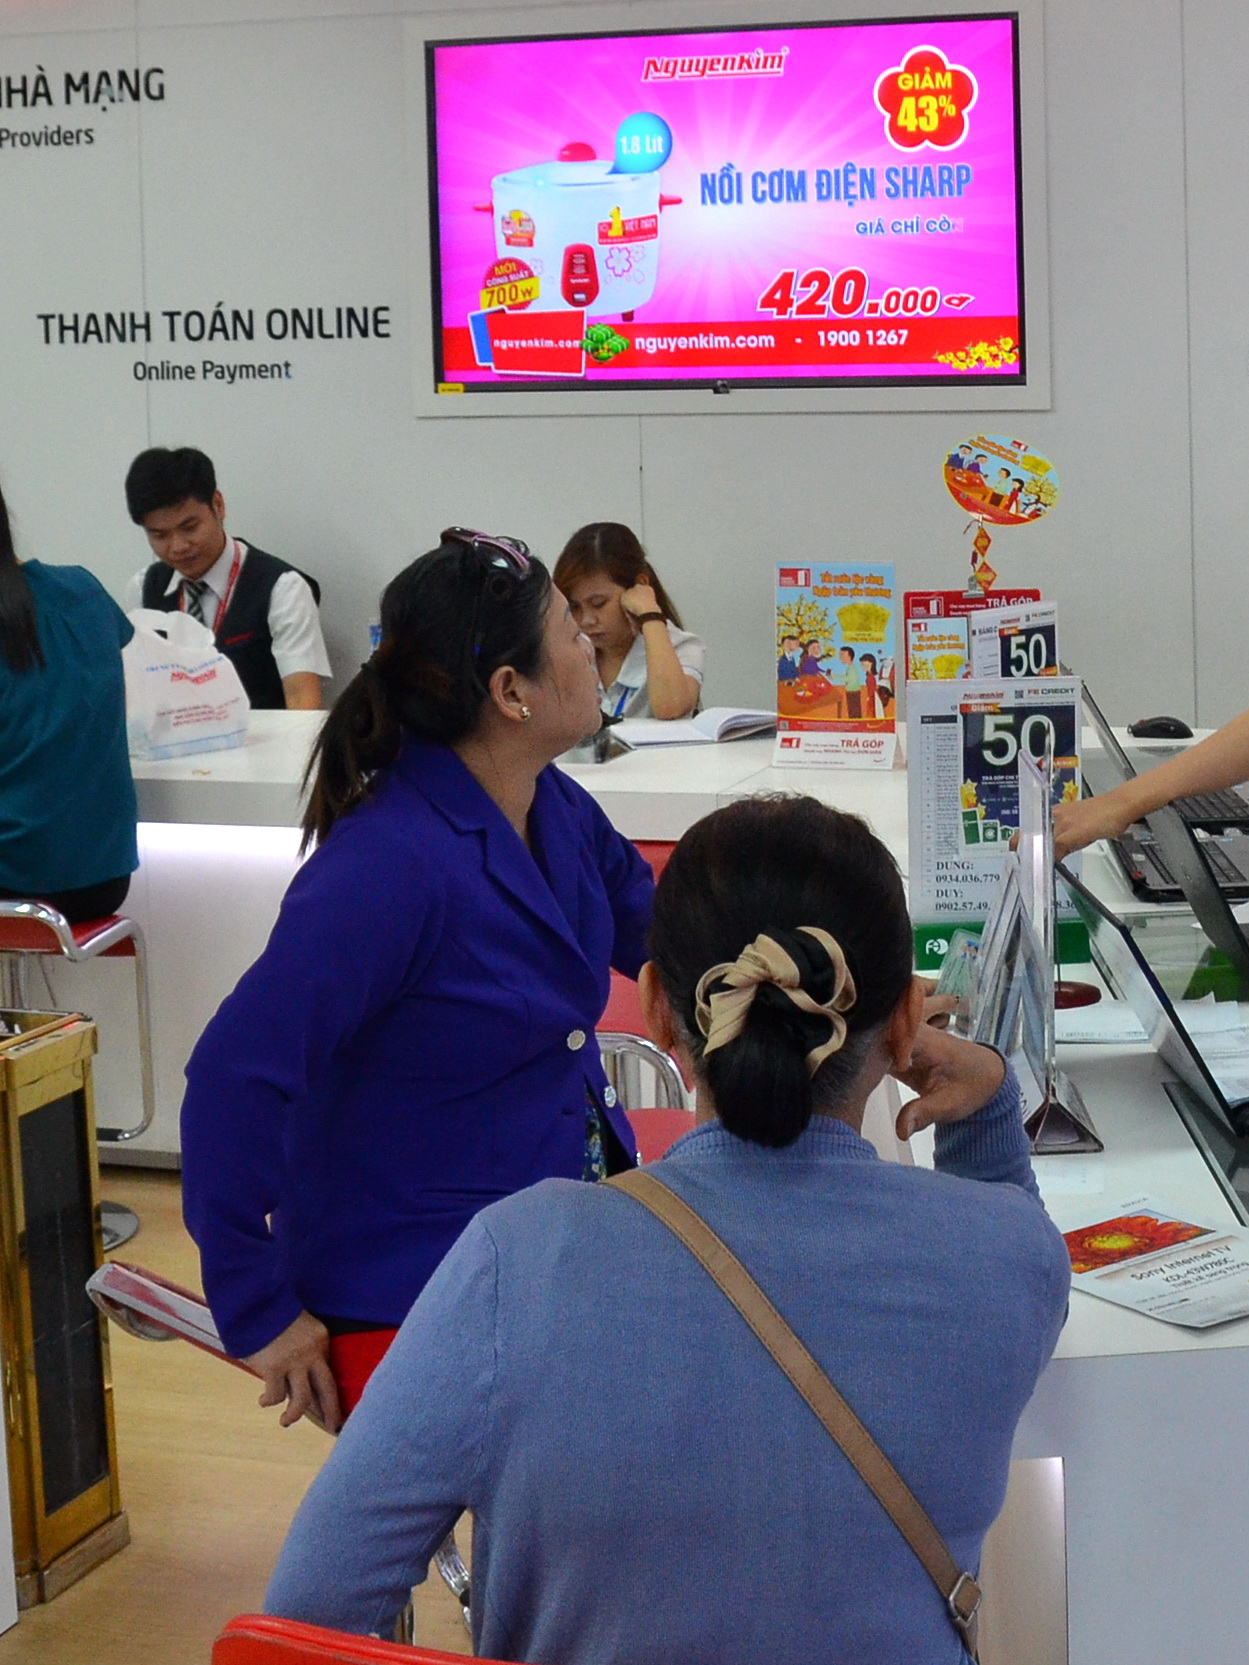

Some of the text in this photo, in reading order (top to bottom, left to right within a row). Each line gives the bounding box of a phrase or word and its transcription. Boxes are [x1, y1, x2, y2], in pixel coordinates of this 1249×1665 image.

[643, 49, 784, 79] NguyenKim
[64, 68, 165, 111] MẠNG
[898, 66, 953, 90] GIẢM
[897, 95, 955, 132] 43%
[0, 126, 94, 148] Providers
[621, 136, 640, 154] 1.8
[700, 162, 972, 207] NỒI CƠM ĐIỆN SHARP
[855, 216, 885, 235] GIÁ
[891, 215, 920, 234] CHỈ
[486, 283, 519, 308] 700
[756, 267, 941, 319] 420.000
[37, 301, 391, 344] THANH TOÁN ONLINE
[493, 337, 581, 351] nguyenkim.com
[634, 332, 775, 354] nguyenkim.com
[818, 331, 861, 347] 1900
[866, 330, 908, 346] 1267
[133, 359, 292, 384] Online Payment
[1010, 633, 1047, 678] 50
[982, 714, 1056, 766] 50
[936, 889, 963, 898] DUY:
[935, 902, 991, 911] 0902.57.49.
